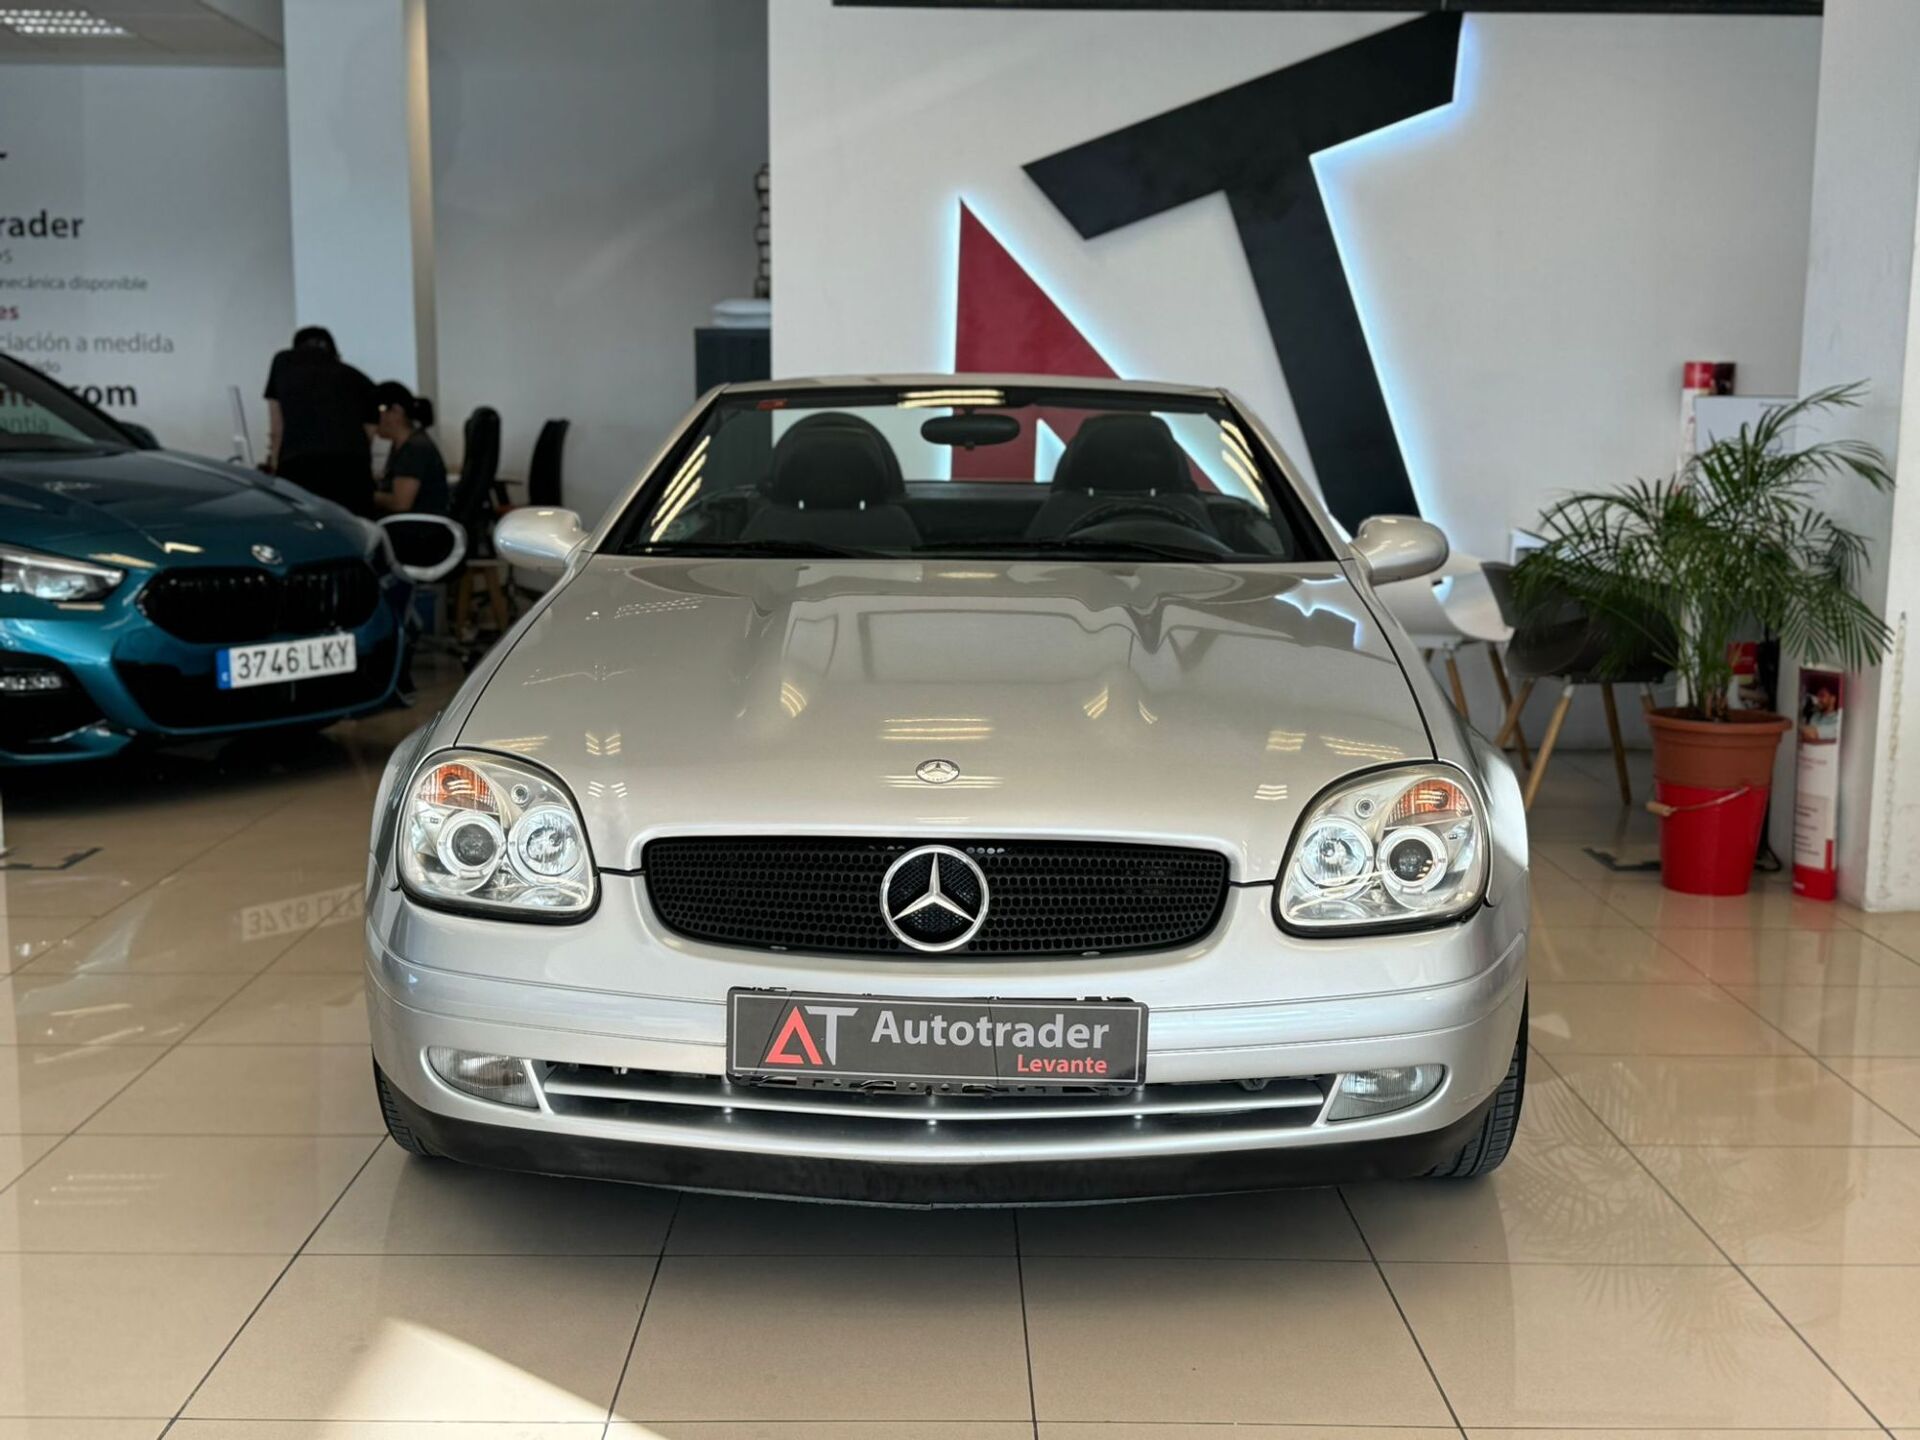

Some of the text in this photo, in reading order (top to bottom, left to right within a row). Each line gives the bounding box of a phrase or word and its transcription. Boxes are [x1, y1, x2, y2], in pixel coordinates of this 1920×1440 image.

[76, 336, 88, 351] a
[93, 331, 174, 353] medida
[237, 639, 349, 679] 3746 LKY
[871, 1009, 1109, 1049] Autotrader
[1017, 1054, 1108, 1074] Levante
